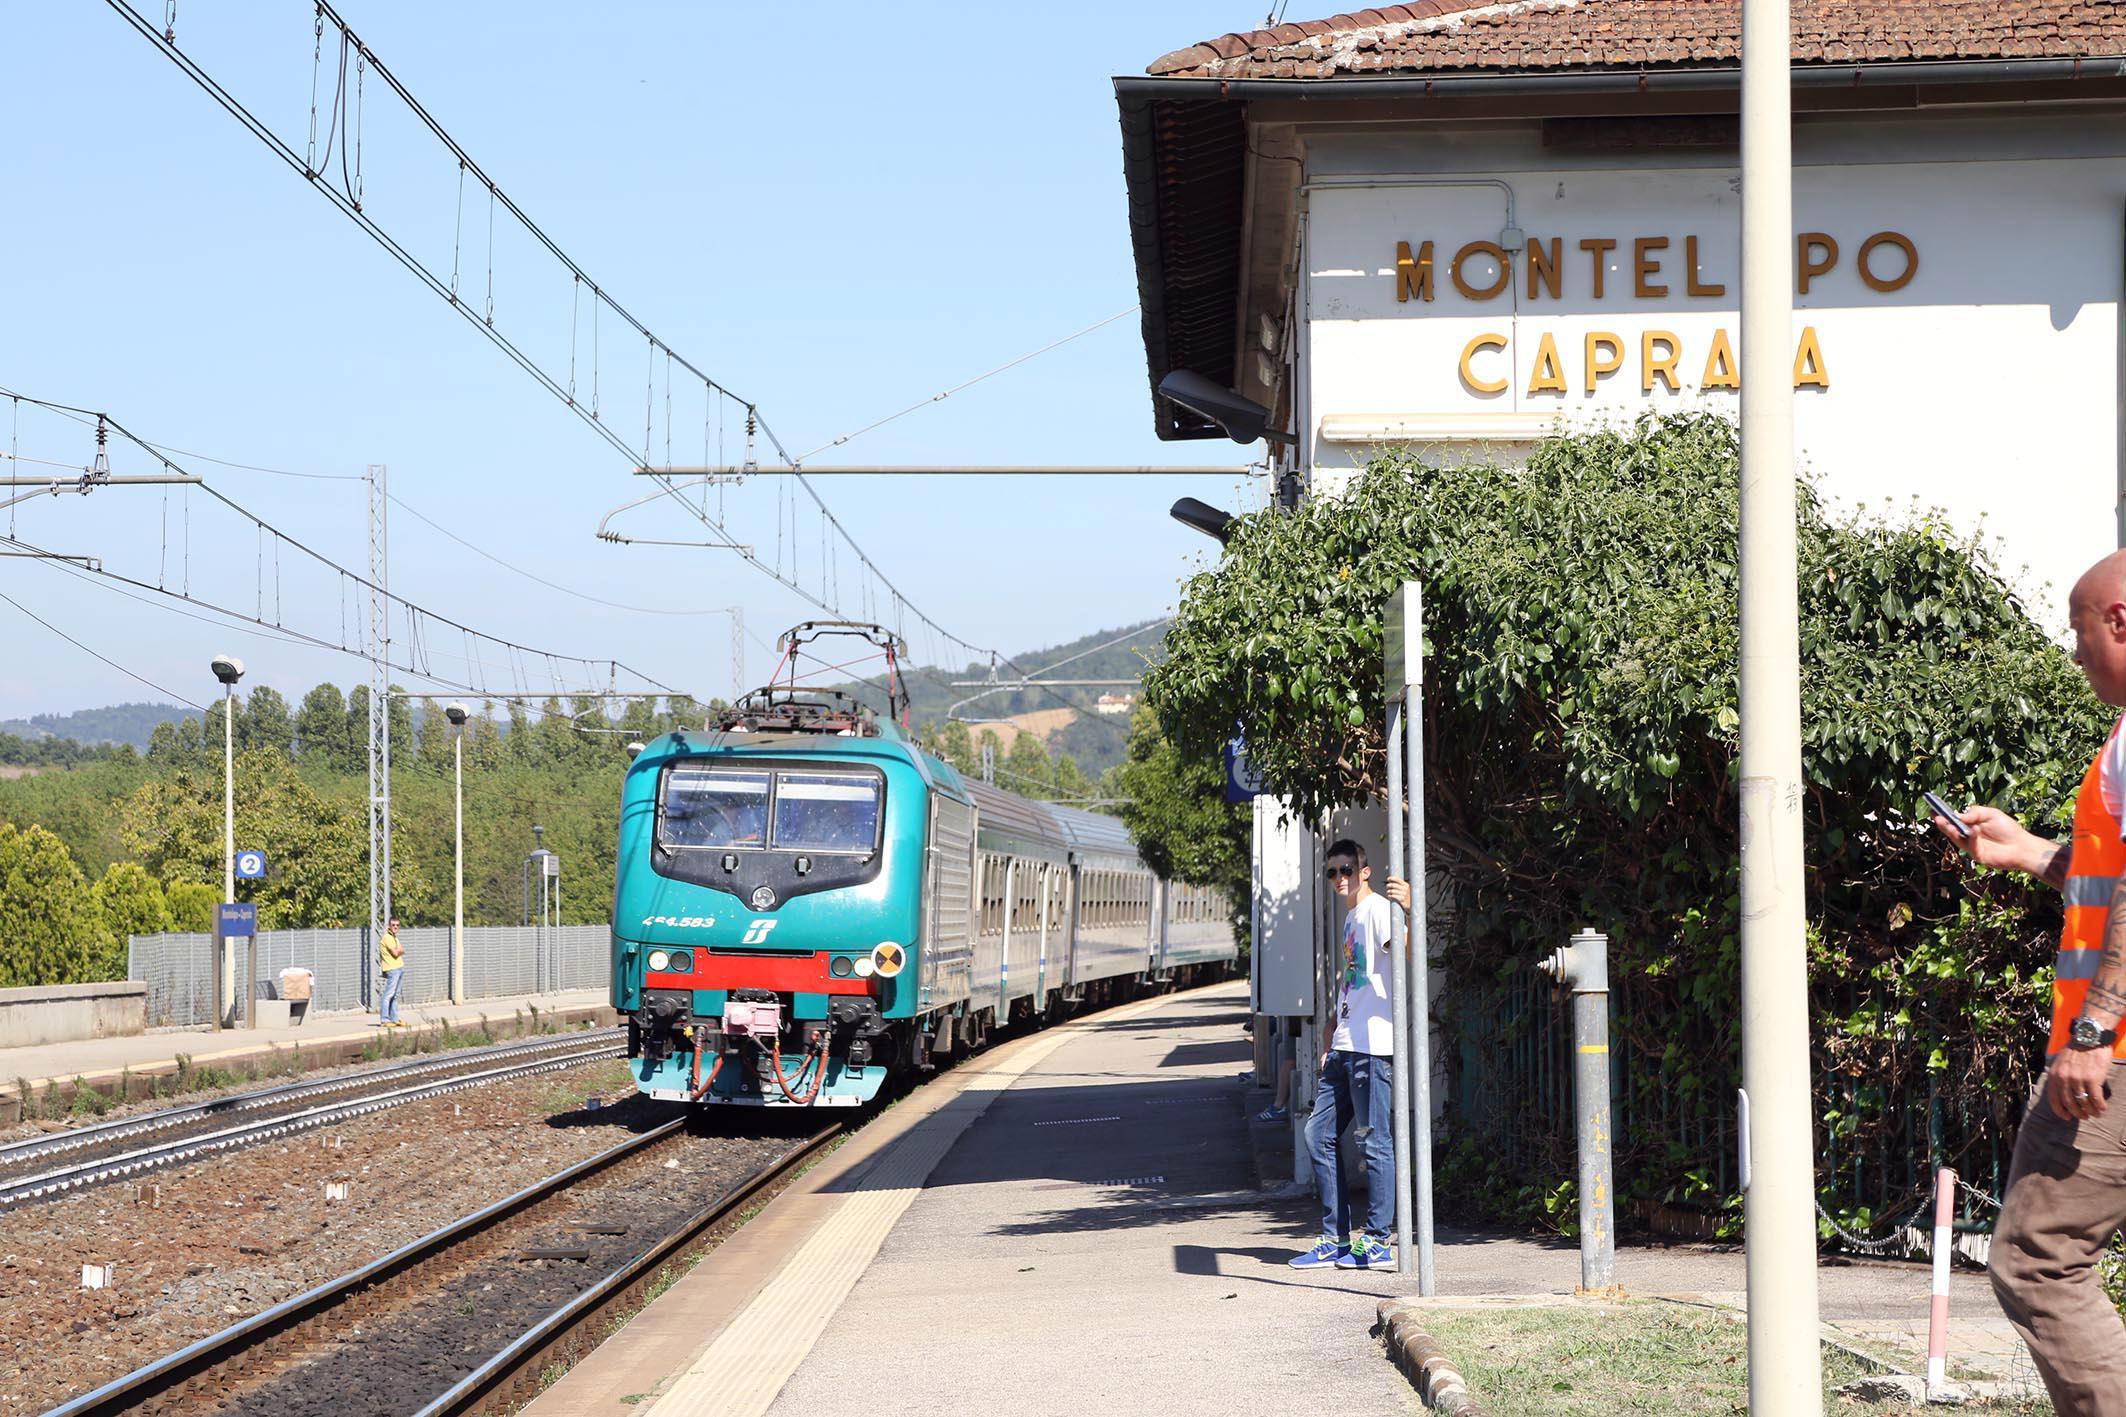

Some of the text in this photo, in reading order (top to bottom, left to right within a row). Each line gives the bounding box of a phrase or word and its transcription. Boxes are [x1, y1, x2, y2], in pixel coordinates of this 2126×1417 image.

[1396, 231, 1919, 302] MONTELPO
[1459, 326, 1830, 392] CAPRAA
[245, 858, 256, 871] 2
